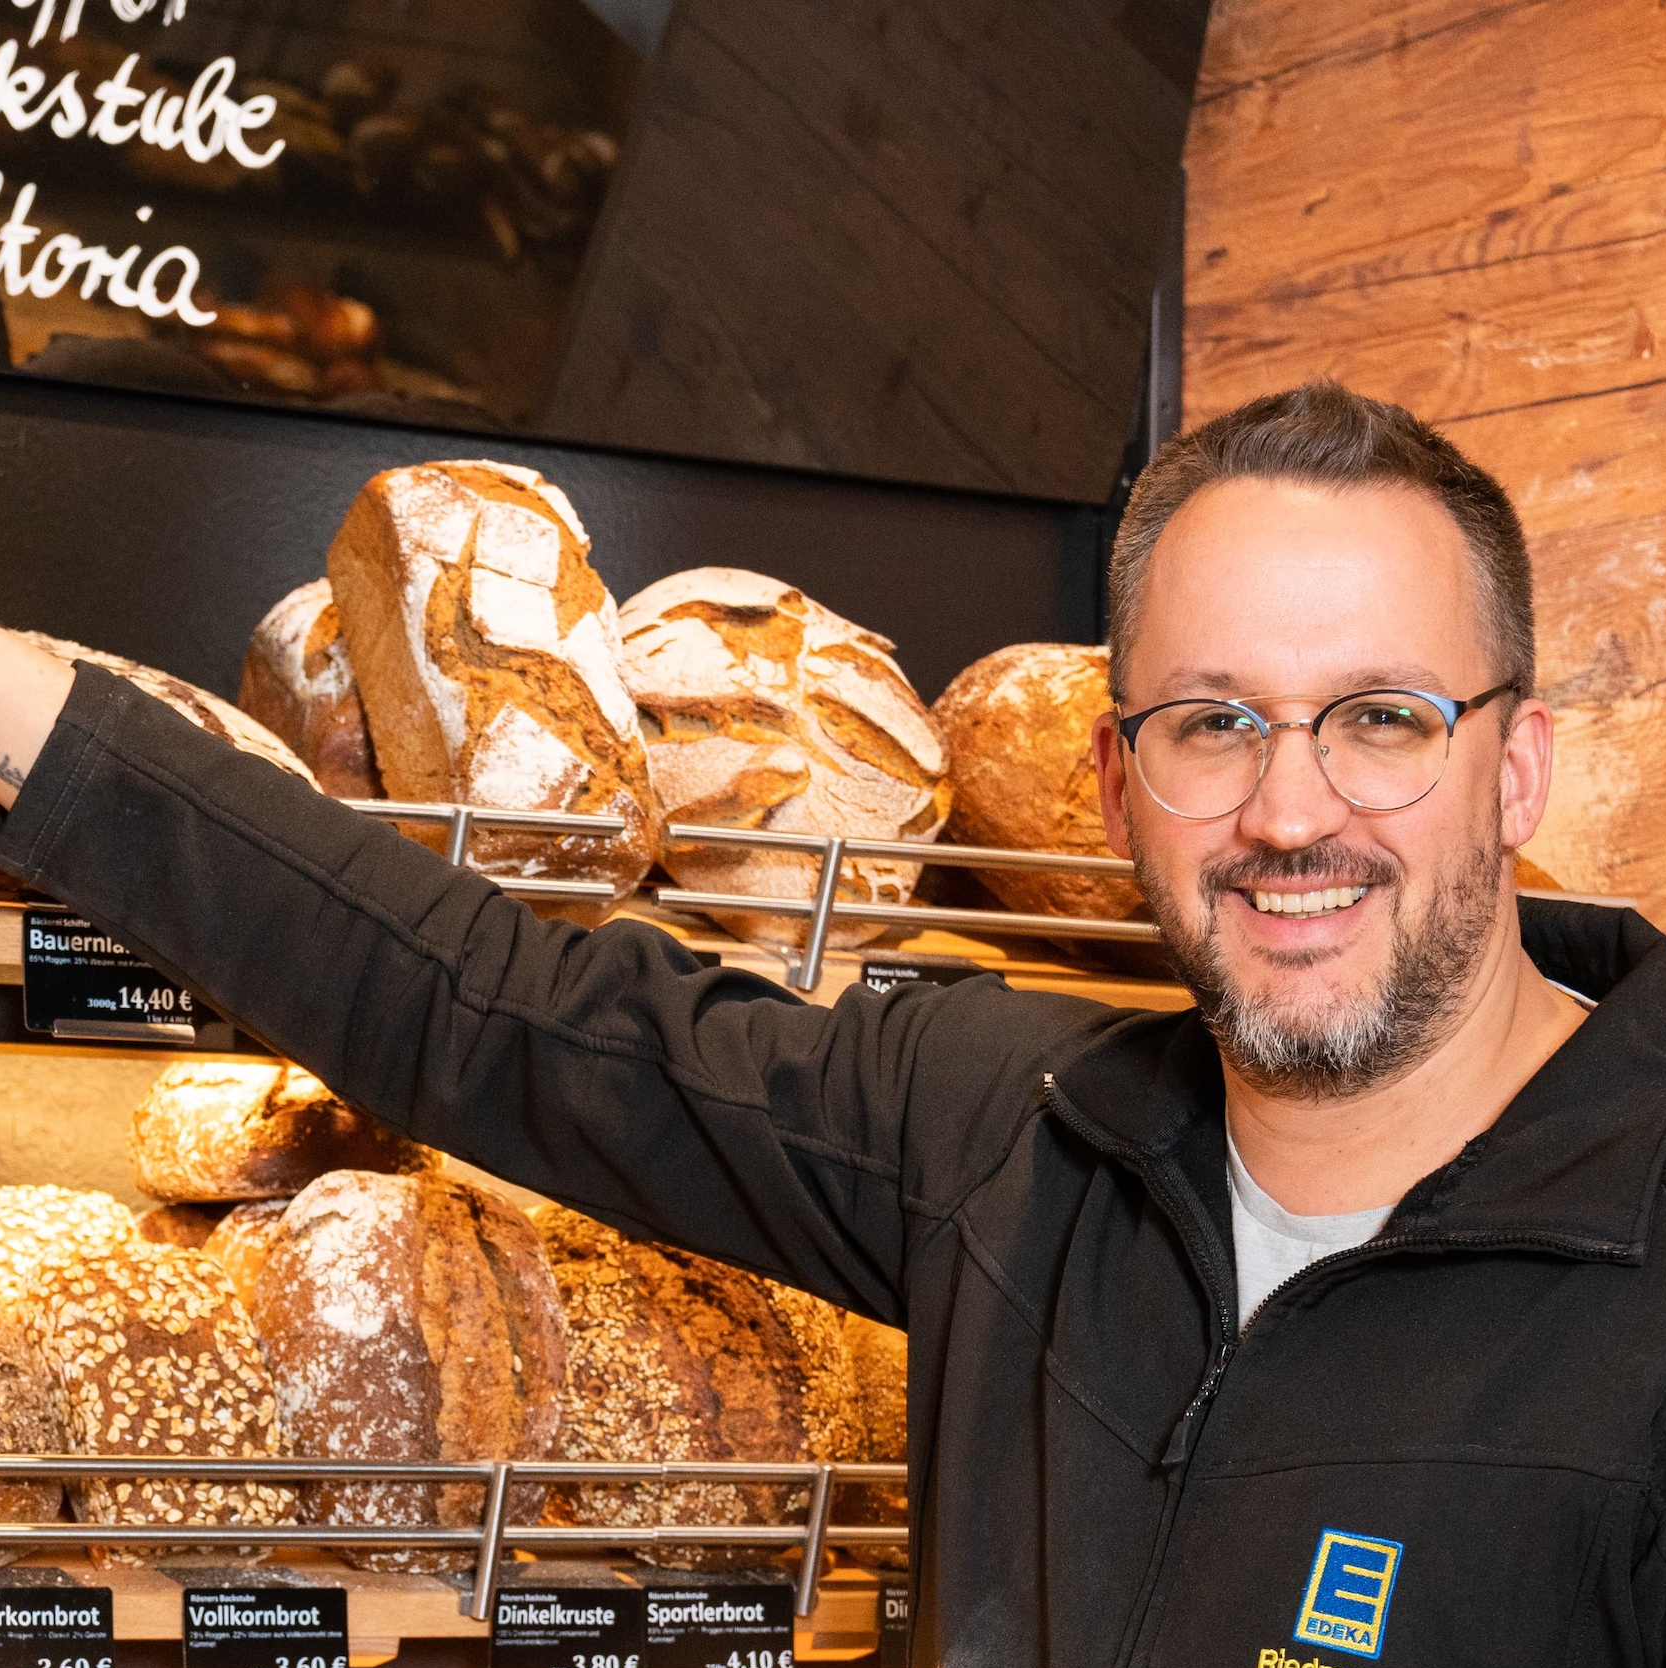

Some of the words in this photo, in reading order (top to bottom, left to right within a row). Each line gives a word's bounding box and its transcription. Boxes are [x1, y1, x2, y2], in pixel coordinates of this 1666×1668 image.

[87, 998, 117, 1011] 3000g
[119, 986, 175, 1013] 14,40
[179, 990, 193, 1012] €
[189, 1604, 320, 1626] Vollkornbrot
[498, 1604, 616, 1625] Dinkelkruste
[647, 1601, 764, 1627] Sportlerbrot
[1306, 1617, 1372, 1647] EDEKA
